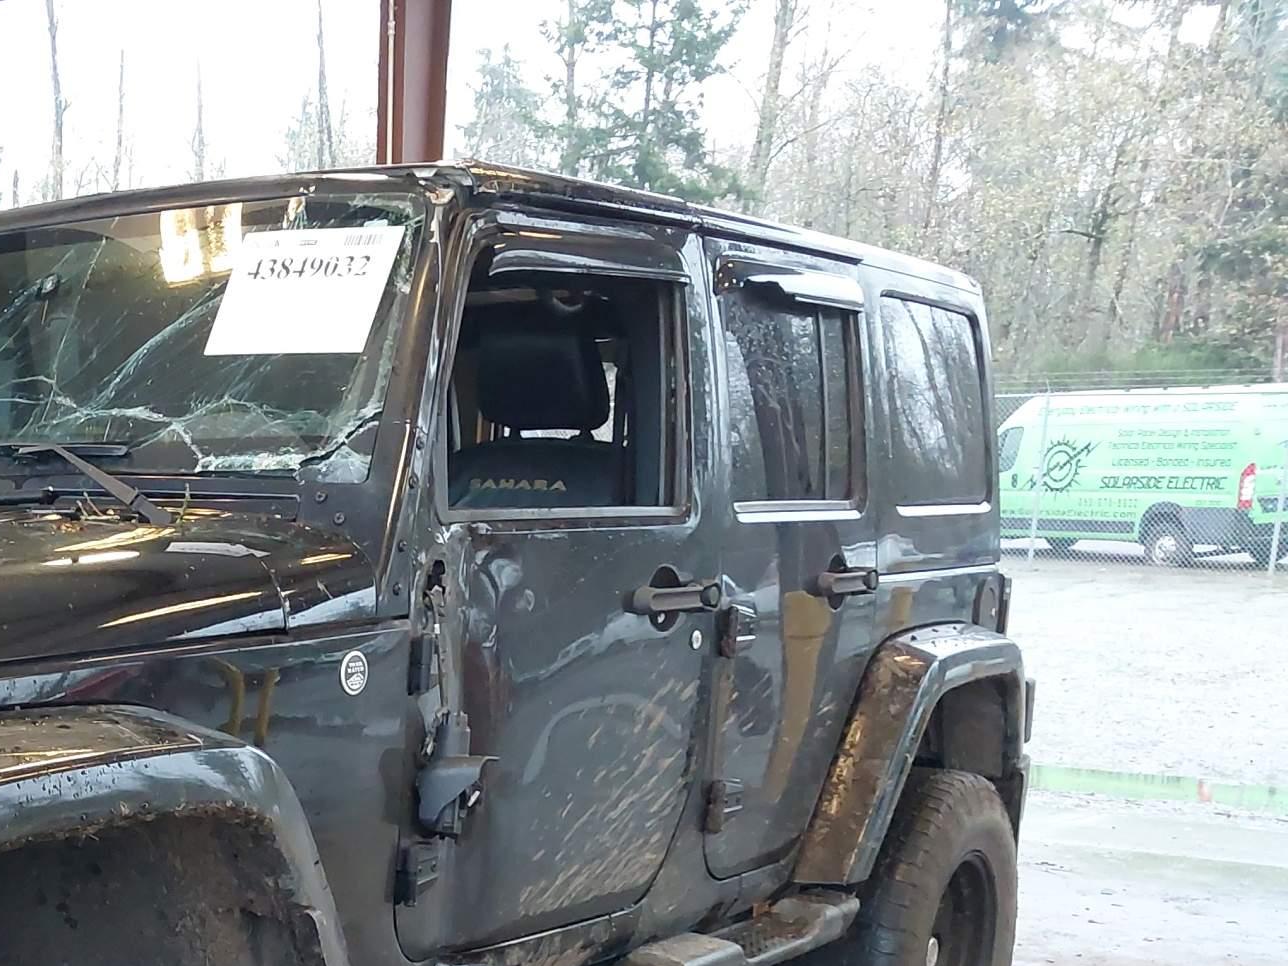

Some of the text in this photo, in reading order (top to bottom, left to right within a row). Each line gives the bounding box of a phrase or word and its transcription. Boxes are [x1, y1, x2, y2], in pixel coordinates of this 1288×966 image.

[247, 255, 371, 280] 43849032
[469, 478, 568, 491] SAHARA
[1099, 475, 1229, 490] SOLARSIDE ELECTRIC
